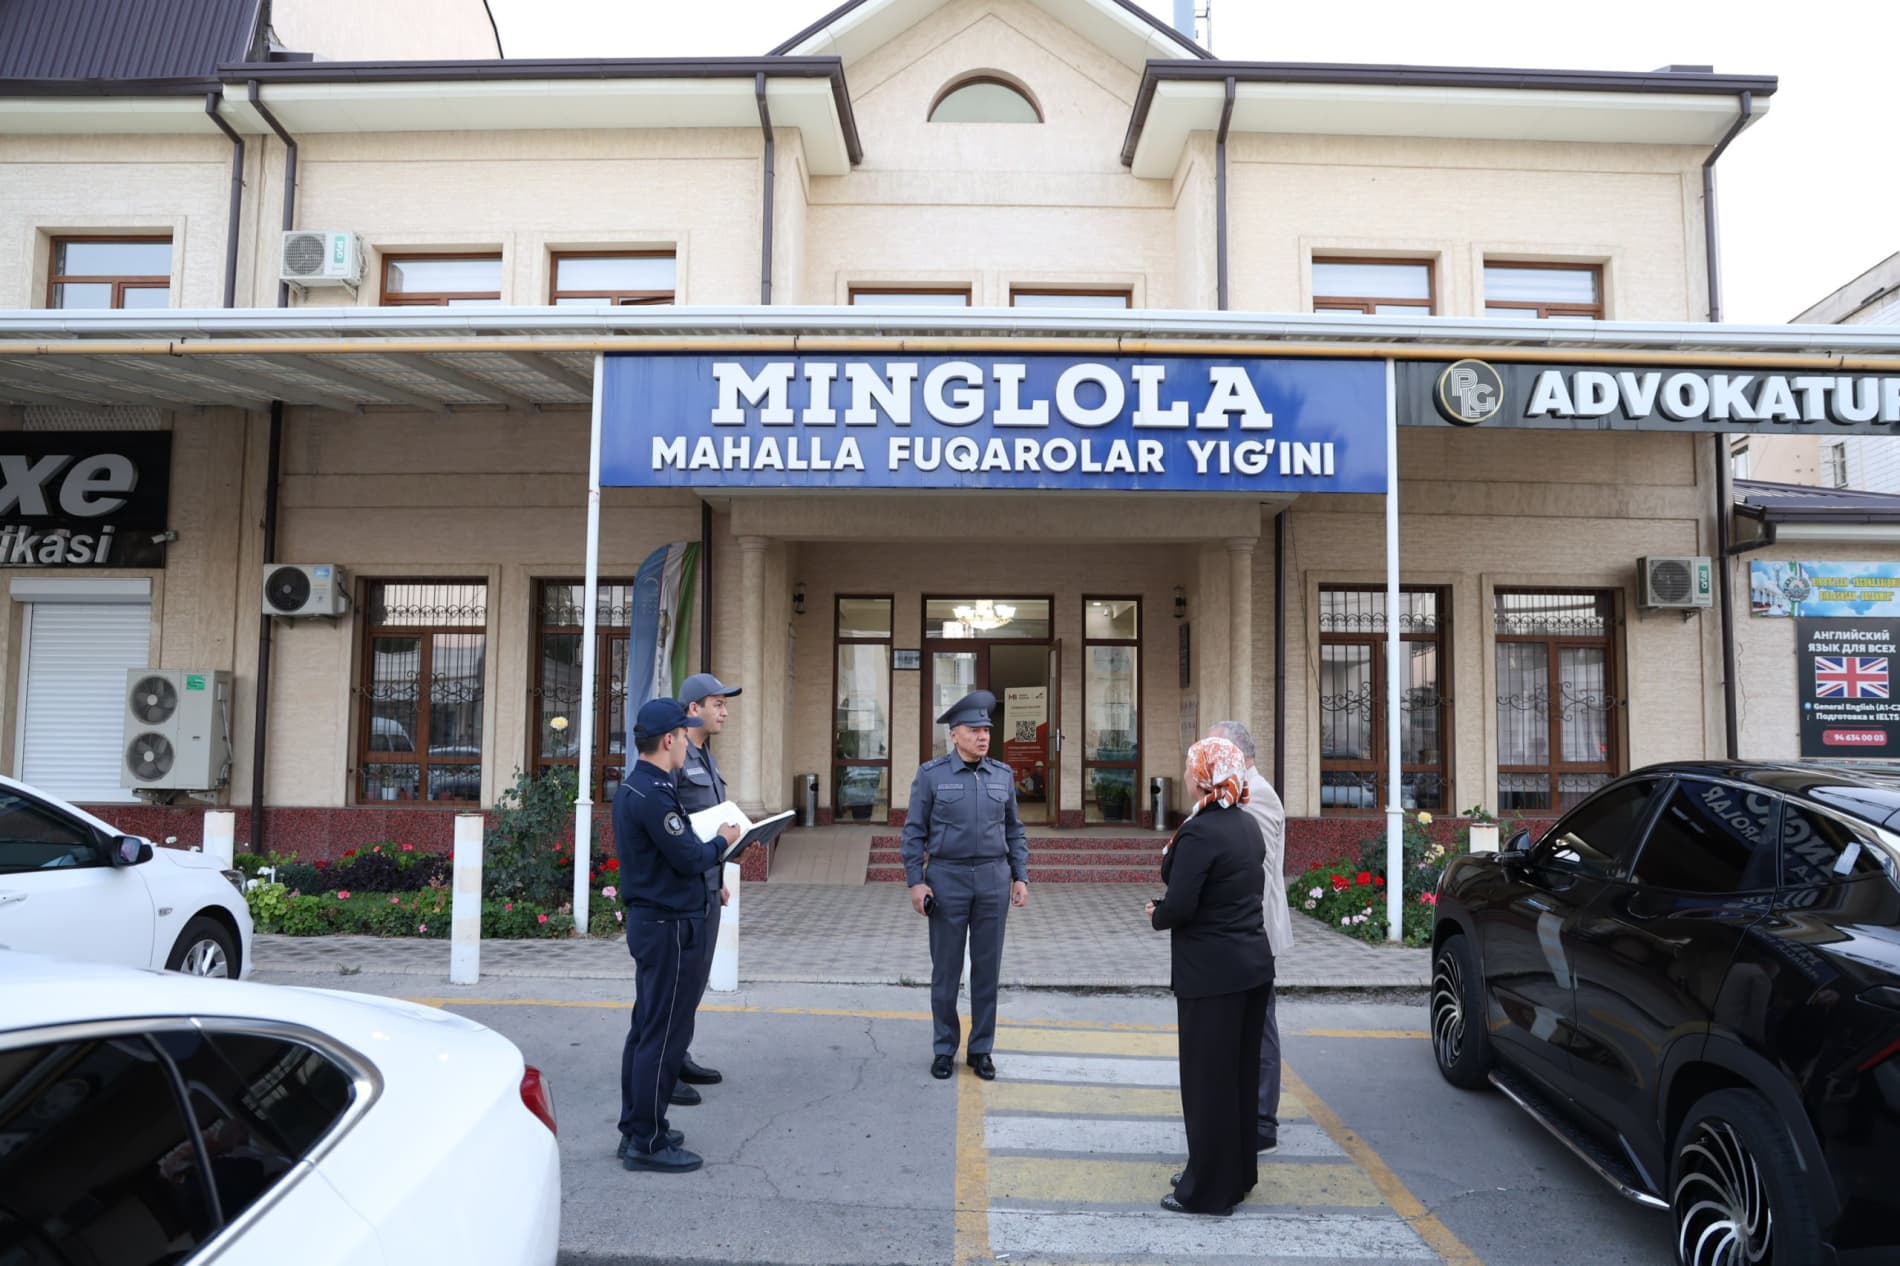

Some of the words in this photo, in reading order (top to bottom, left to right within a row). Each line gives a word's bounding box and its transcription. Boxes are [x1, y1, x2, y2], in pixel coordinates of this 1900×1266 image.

[711, 360, 1274, 429] MINGLOLA
[652, 436, 865, 472] MAHALLA
[888, 437, 1165, 474] FUQAROLAR
[1187, 438, 1335, 475] YIG'INI
[1813, 629, 1890, 641] АНГЛИЙСКИЙ
[1808, 643, 1840, 653] ЯЗЫК
[1842, 643, 1866, 654] ДЛЯ
[1868, 644, 1896, 653] ВСЕХ
[1813, 703, 1844, 711] General
[1846, 703, 1875, 712] English
[1816, 712, 1867, 722] Подготовка
[1876, 712, 1899, 721] IELTS
